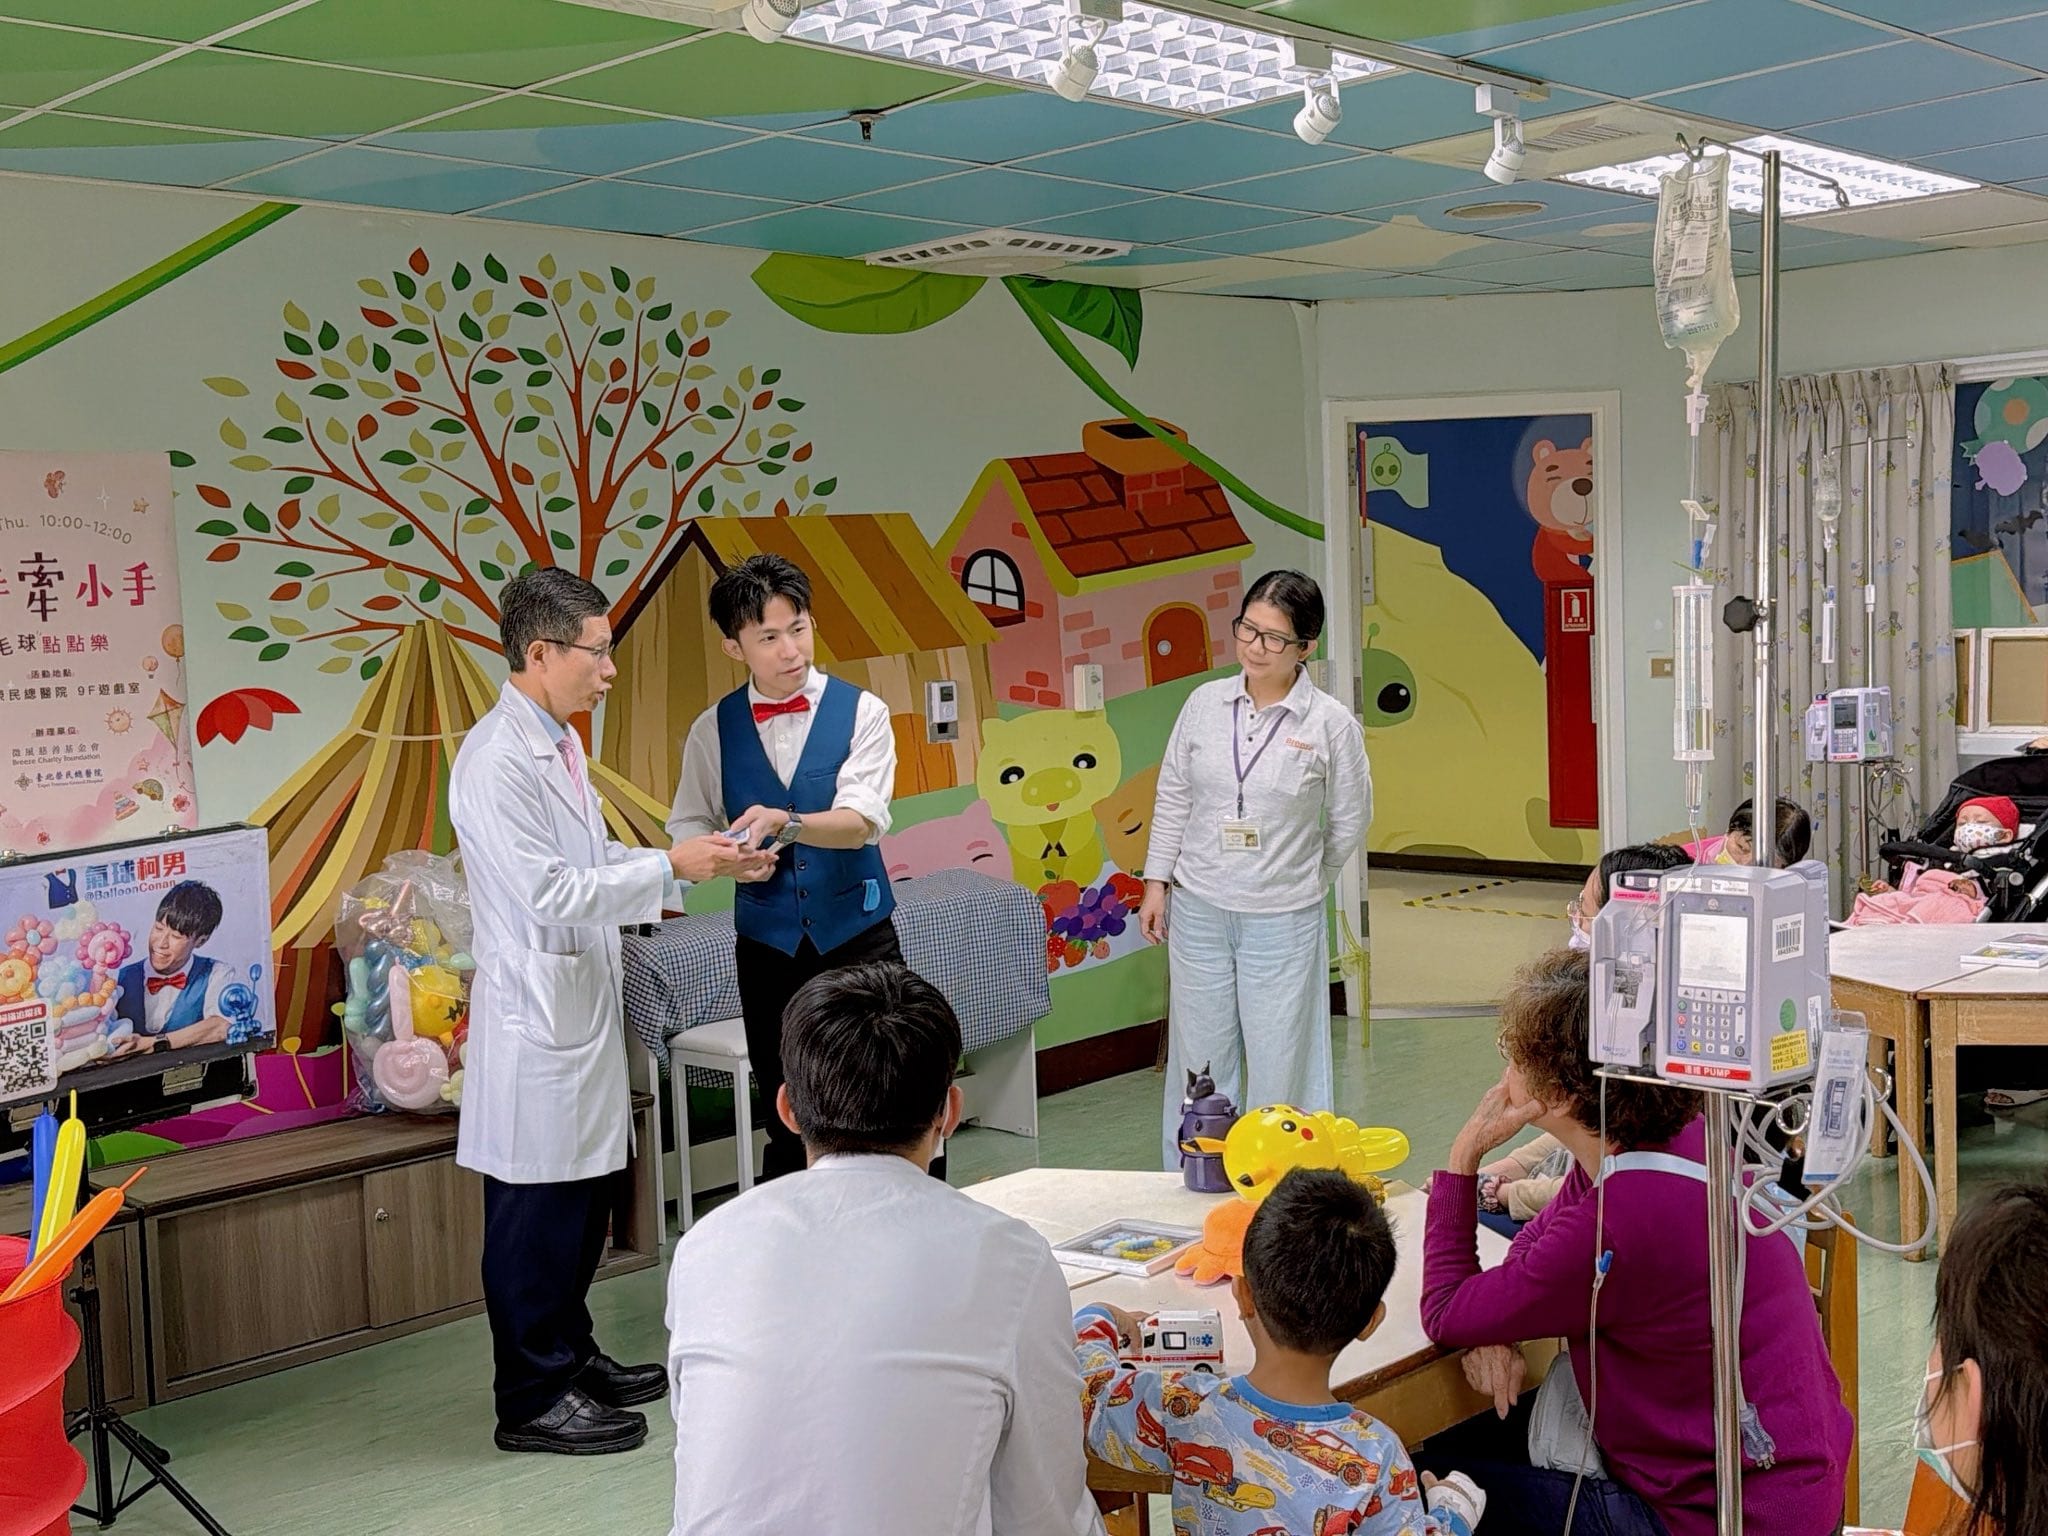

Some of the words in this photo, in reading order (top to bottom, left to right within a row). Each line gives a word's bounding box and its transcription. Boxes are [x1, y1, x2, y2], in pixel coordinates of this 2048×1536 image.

[40, 514, 132, 544] 10:00-12:00
[31, 668, 72, 679] 活動地點
[86, 851, 186, 890] 氣球柯男
[85, 880, 176, 901] @BalloonConan
[1704, 1068, 1731, 1078] PUMP
[1188, 1335, 1201, 1346] 119
